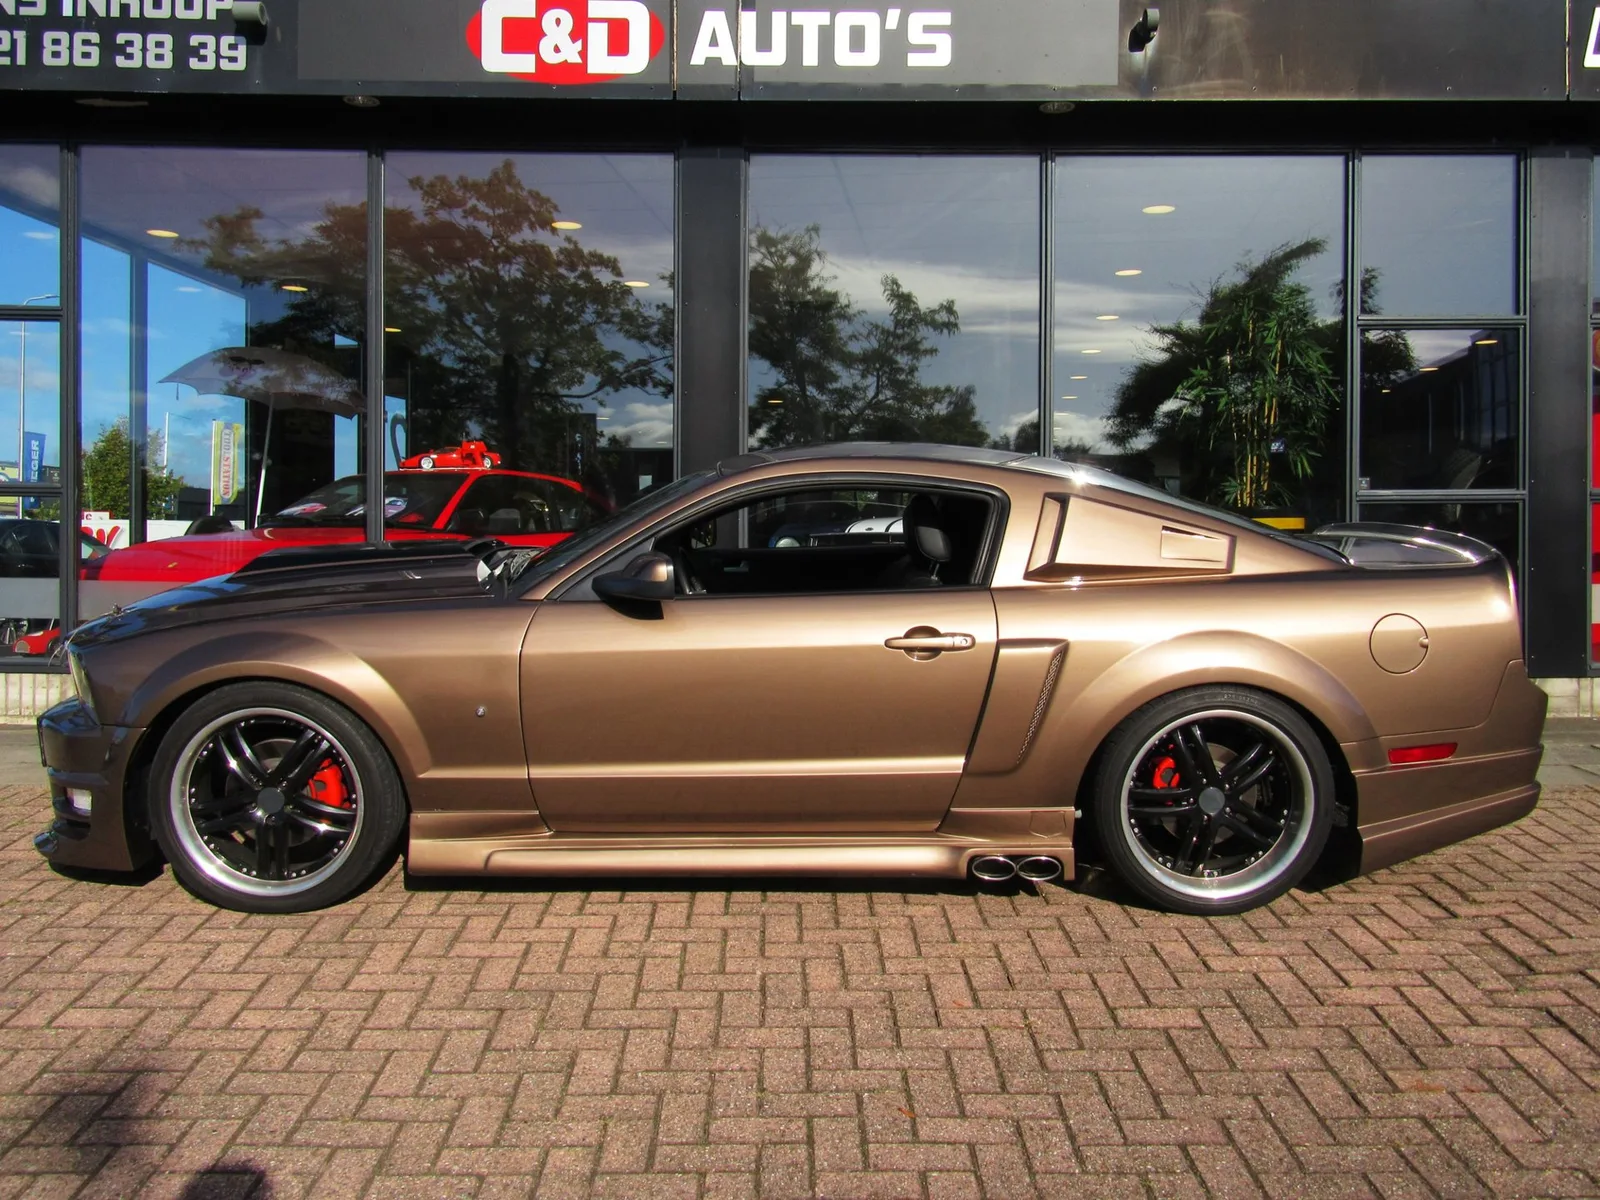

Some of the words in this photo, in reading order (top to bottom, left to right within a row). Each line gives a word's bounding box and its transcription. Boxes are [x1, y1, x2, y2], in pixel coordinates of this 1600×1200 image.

[43, 31, 101, 67] 86
[115, 33, 174, 69] 38
[189, 35, 247, 71] 39
[481, 0, 650, 74] C&D
[690, 9, 953, 67] AUTO'S
